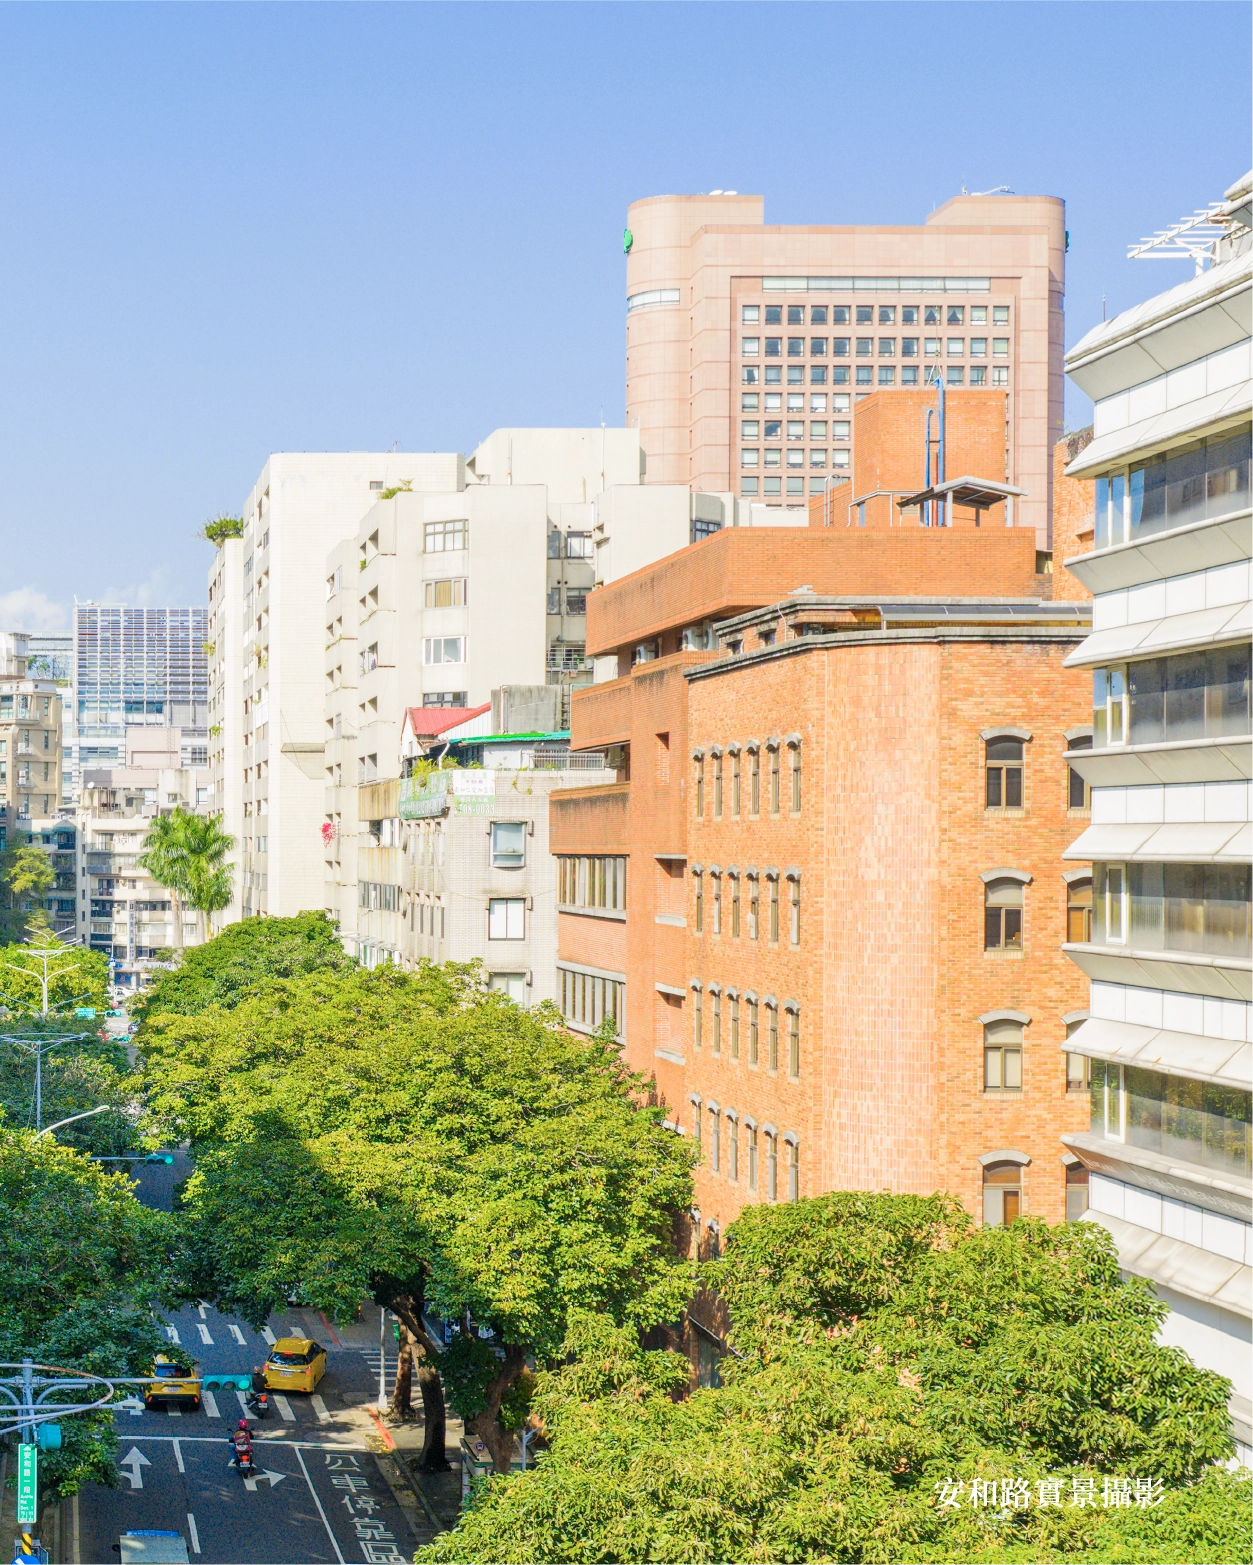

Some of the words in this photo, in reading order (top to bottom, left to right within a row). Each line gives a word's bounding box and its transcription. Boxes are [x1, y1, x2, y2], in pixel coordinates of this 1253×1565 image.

[23, 1452, 31, 1493] 安和路一段
[325, 1453, 408, 1565] 公車停靠區
